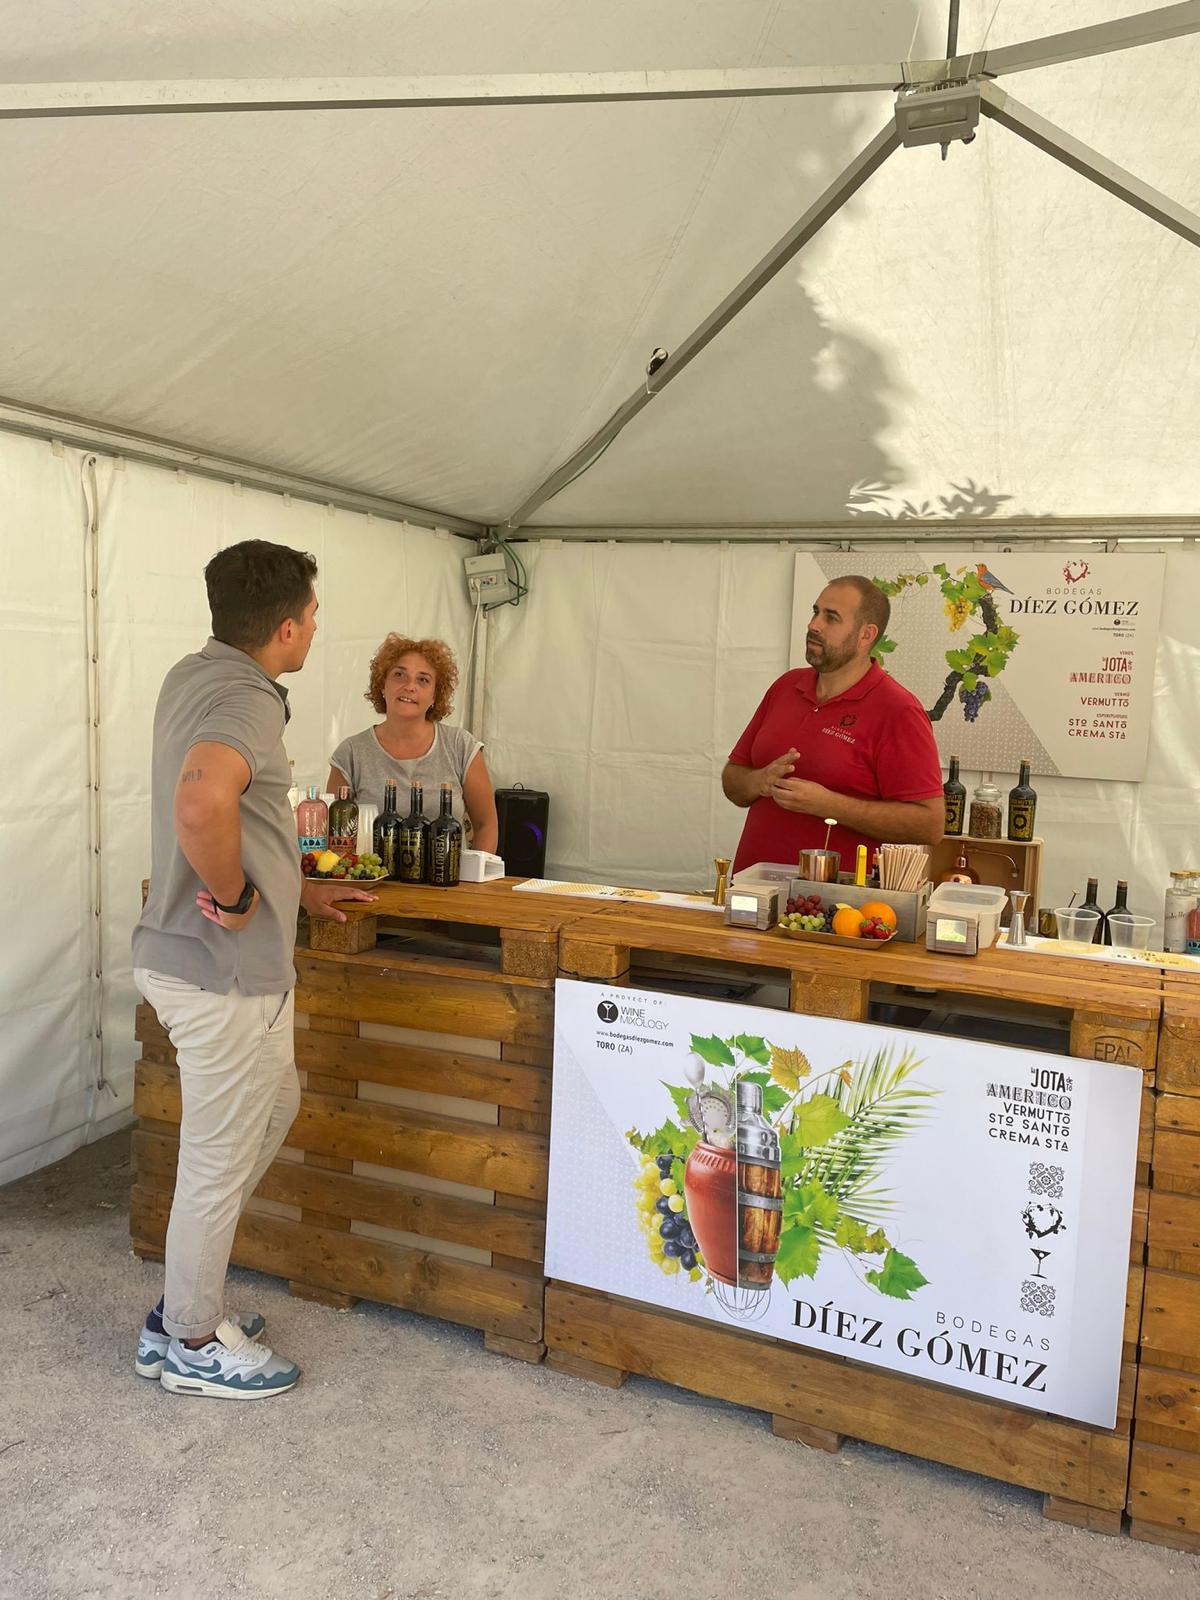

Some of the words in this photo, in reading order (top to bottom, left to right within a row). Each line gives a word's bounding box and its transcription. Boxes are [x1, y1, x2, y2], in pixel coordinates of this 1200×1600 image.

[1010, 596, 1057, 614] DÍEZ
[1063, 597, 1139, 616] GÓMEZ
[1102, 657, 1127, 672] JOTA
[1069, 672, 1132, 685] AMERICO
[1068, 729, 1105, 738] CREMA
[620, 1006, 646, 1018] WINE
[620, 1015, 669, 1030] MIXOLOGY
[596, 1030, 674, 1047] www.bodegasdiezgomez.com
[596, 1040, 615, 1051] TORO
[618, 1044, 633, 1055] (ZA)
[1030, 1068, 1066, 1093] JOTA
[986, 1083, 1072, 1110] AMERICO
[988, 1128, 1040, 1146] CREMA
[936, 1312, 1050, 1351] BODEGAS
[791, 1298, 884, 1349] DÍEZ
[897, 1328, 1049, 1392] GÓMEZ
